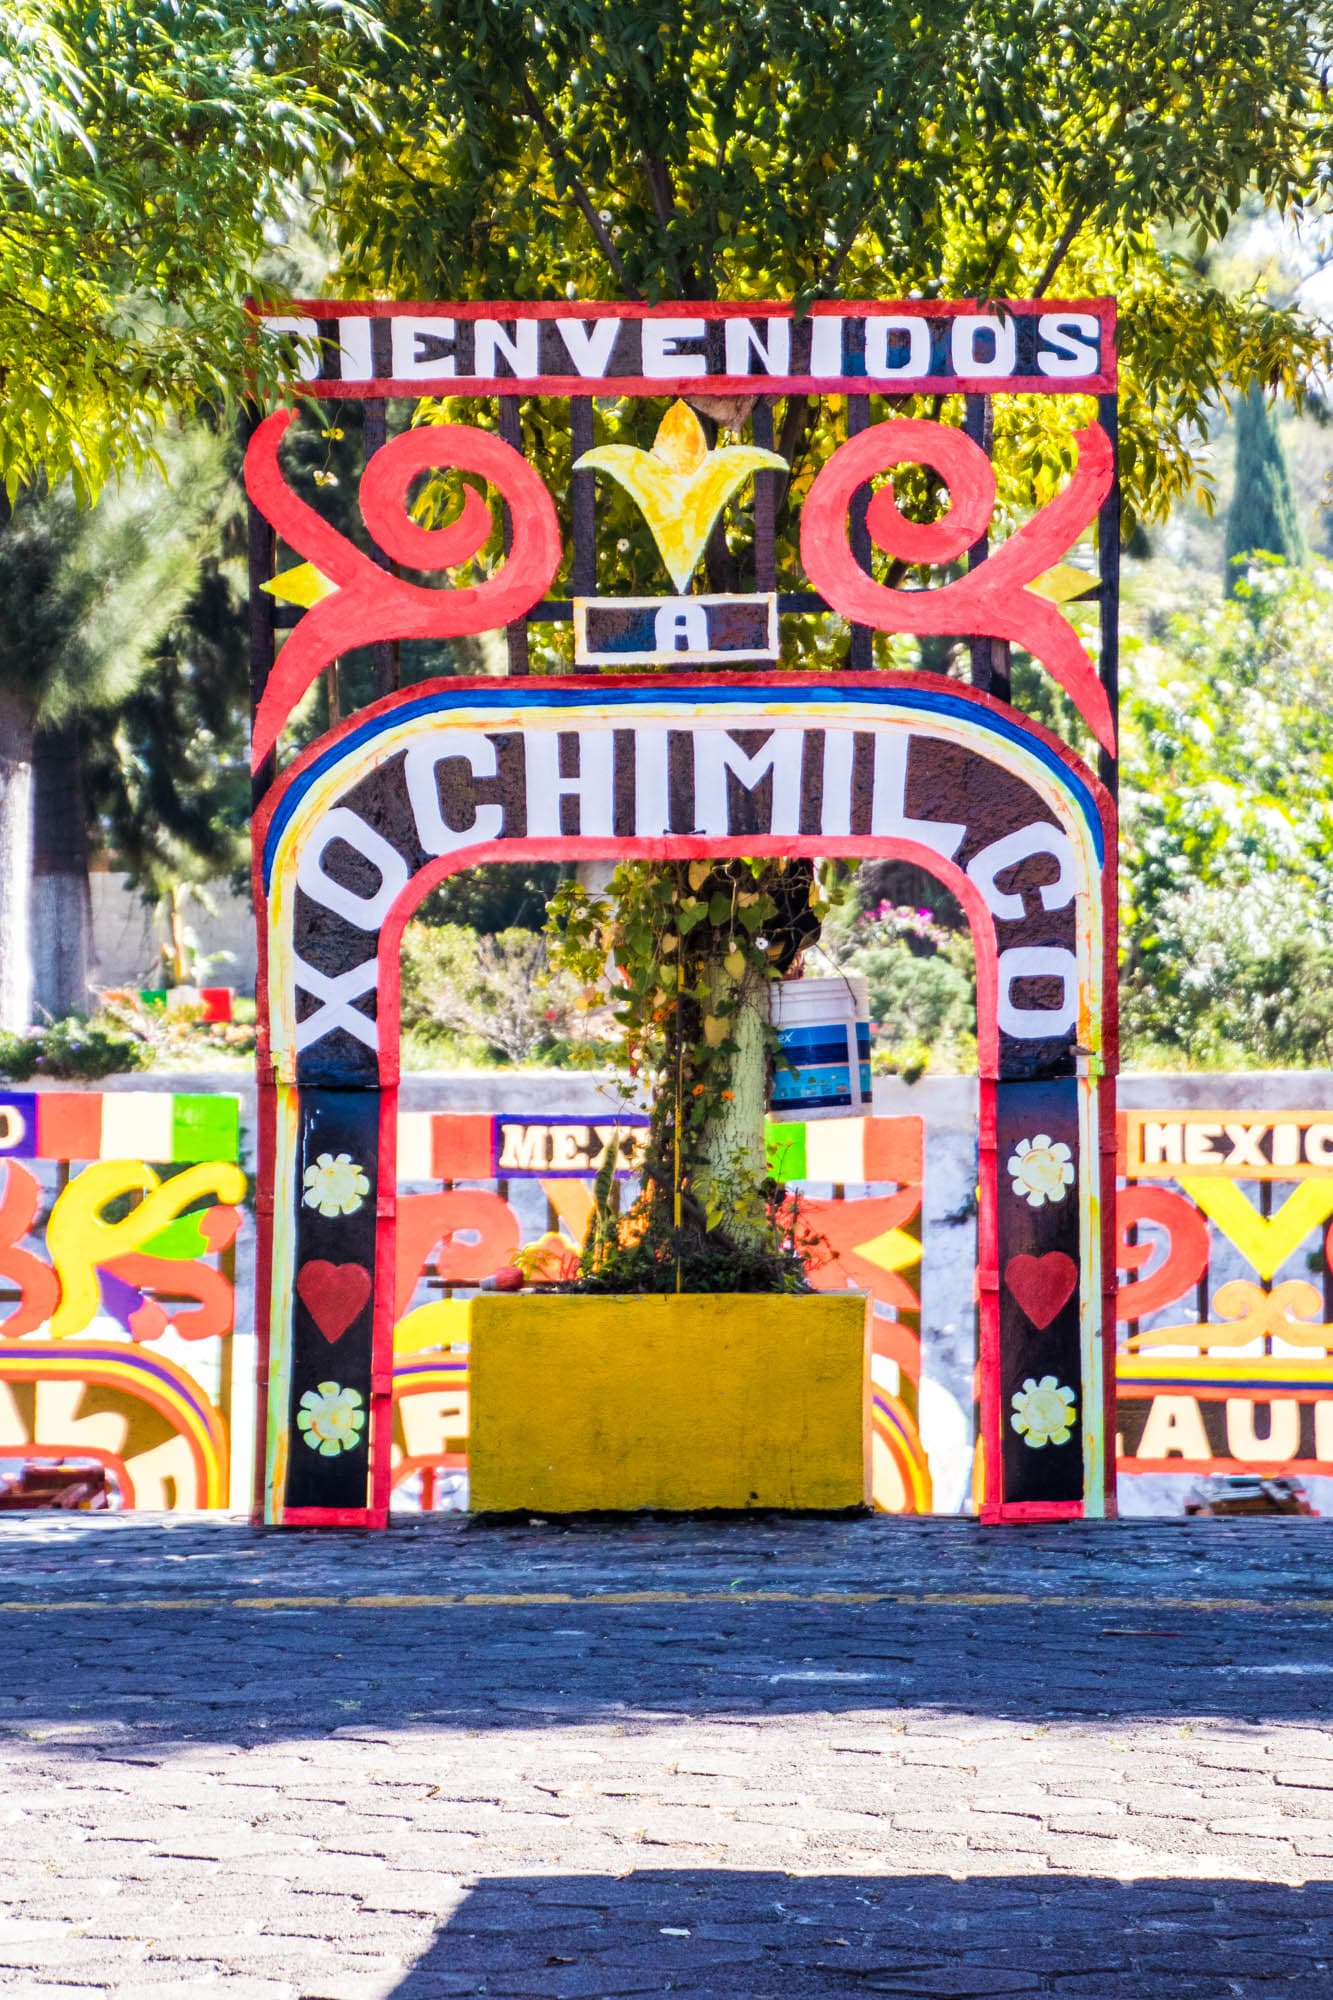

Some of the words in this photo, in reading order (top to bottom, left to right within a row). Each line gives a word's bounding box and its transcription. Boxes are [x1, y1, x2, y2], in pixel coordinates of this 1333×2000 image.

[655, 602, 709, 651] A
[295, 728, 1078, 1052] XOCHIMILCO
[1116, 1396, 1333, 1461] AU
